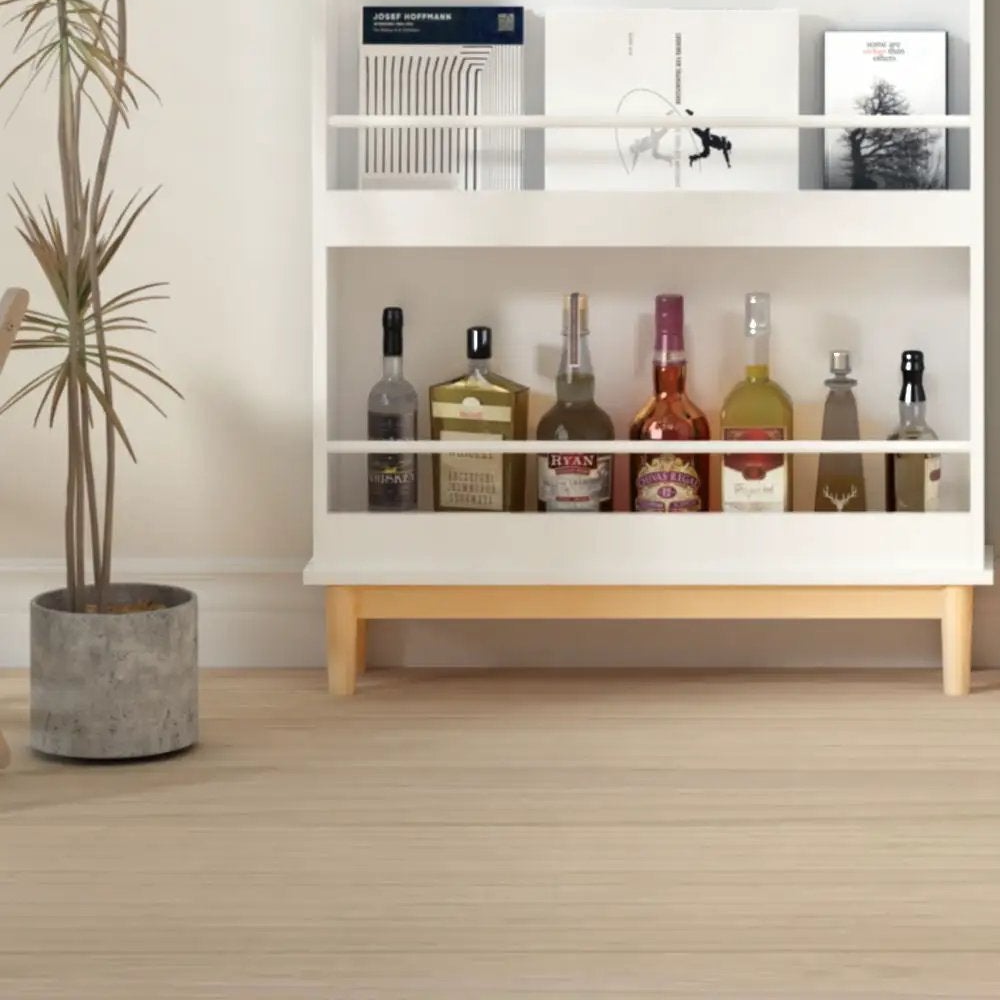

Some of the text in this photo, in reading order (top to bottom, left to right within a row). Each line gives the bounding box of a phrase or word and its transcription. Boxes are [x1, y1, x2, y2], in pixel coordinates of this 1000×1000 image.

[373, 13, 452, 21] JOSEF HOFFMANN
[551, 455, 594, 466] RYAN
